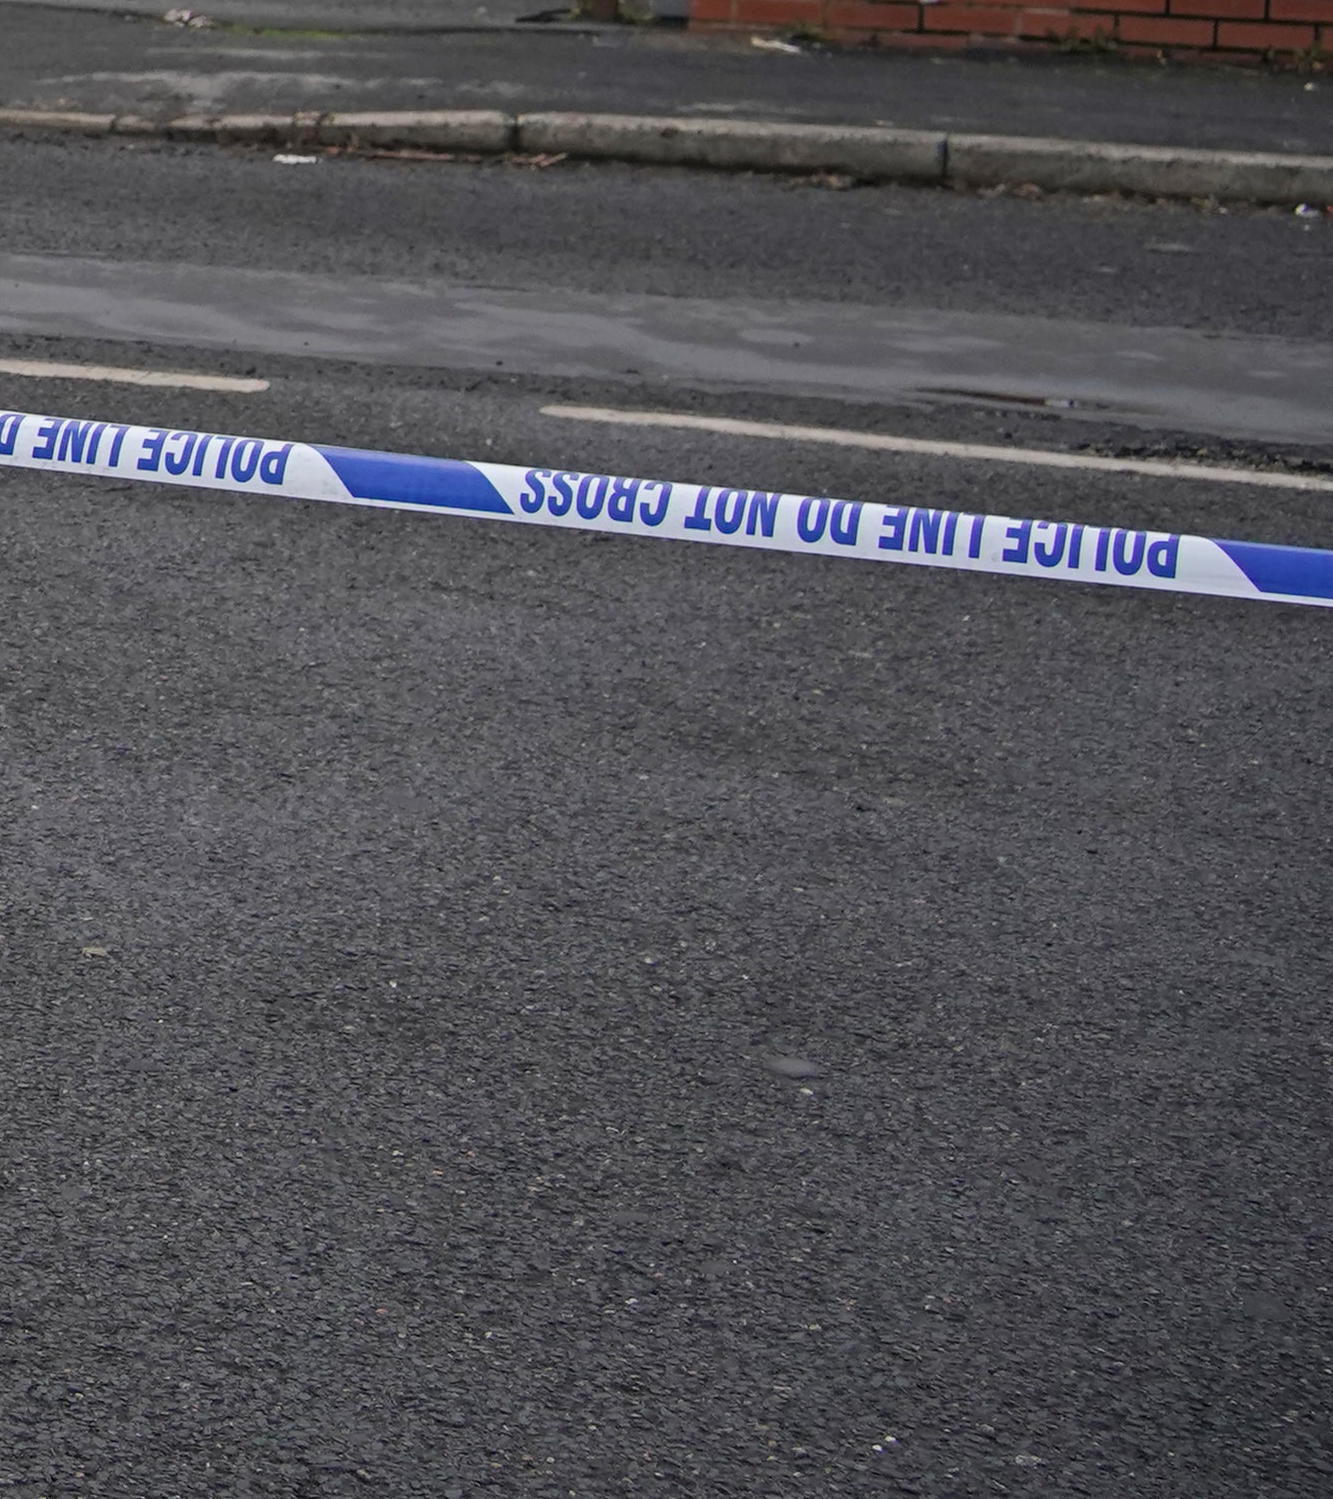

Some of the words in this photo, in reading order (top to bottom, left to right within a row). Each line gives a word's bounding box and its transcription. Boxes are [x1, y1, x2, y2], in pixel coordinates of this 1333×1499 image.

[30, 419, 128, 469] LINE
[136, 429, 292, 485] POLICE
[518, 468, 673, 528] CROSS
[682, 487, 780, 538] NOT
[795, 497, 863, 547] DO
[877, 507, 985, 559] LINE
[1000, 518, 1180, 580] POLICE
